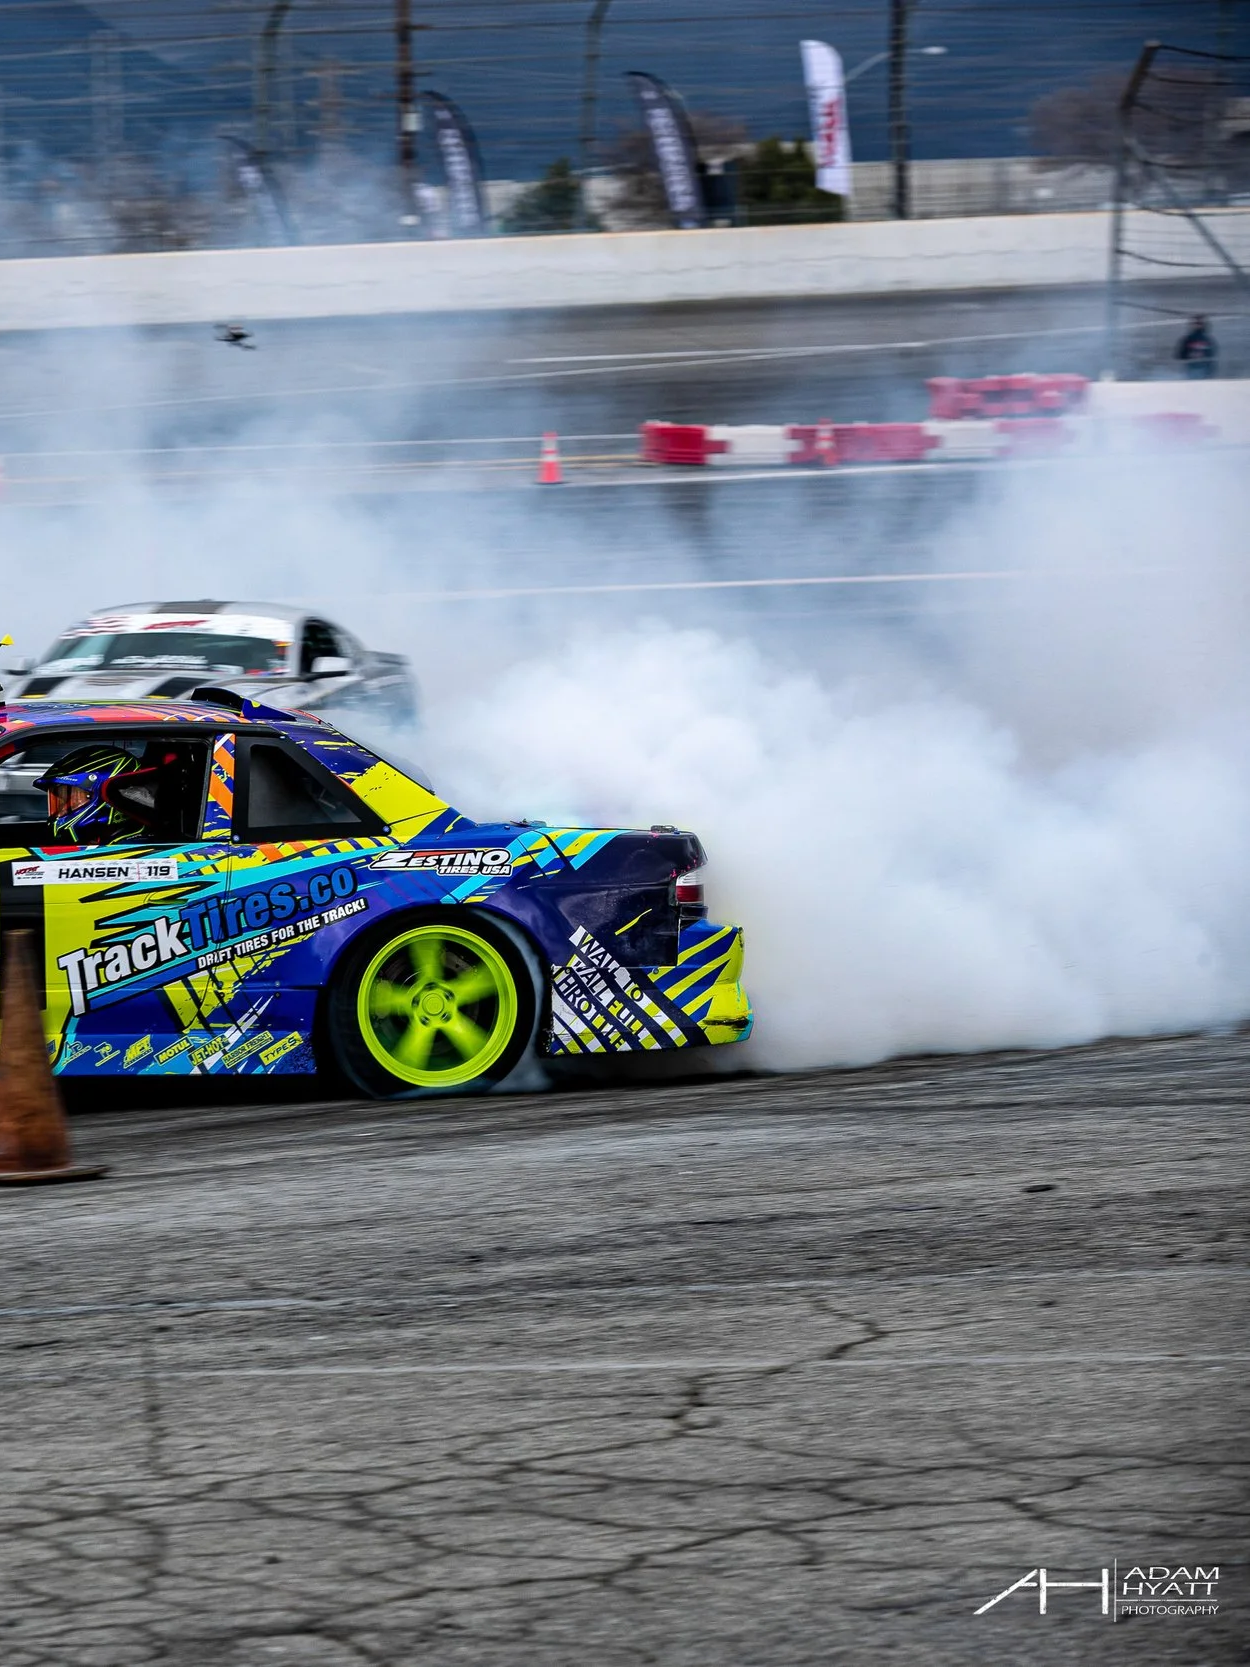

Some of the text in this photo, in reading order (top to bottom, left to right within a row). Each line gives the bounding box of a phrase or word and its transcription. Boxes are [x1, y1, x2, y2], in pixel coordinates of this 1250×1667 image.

[372, 850, 509, 868] ZESTINO
[439, 866, 510, 875] TIRES USA
[58, 867, 129, 879] HANSEN
[147, 866, 170, 877] 119
[198, 898, 366, 969] DRIFT TIRES FOR THE TRACK!
[576, 930, 646, 1003] WALL TO
[605, 996, 644, 1036] FULL
[158, 1039, 190, 1063] MOTUL
[191, 1037, 225, 1065] JET-HOT
